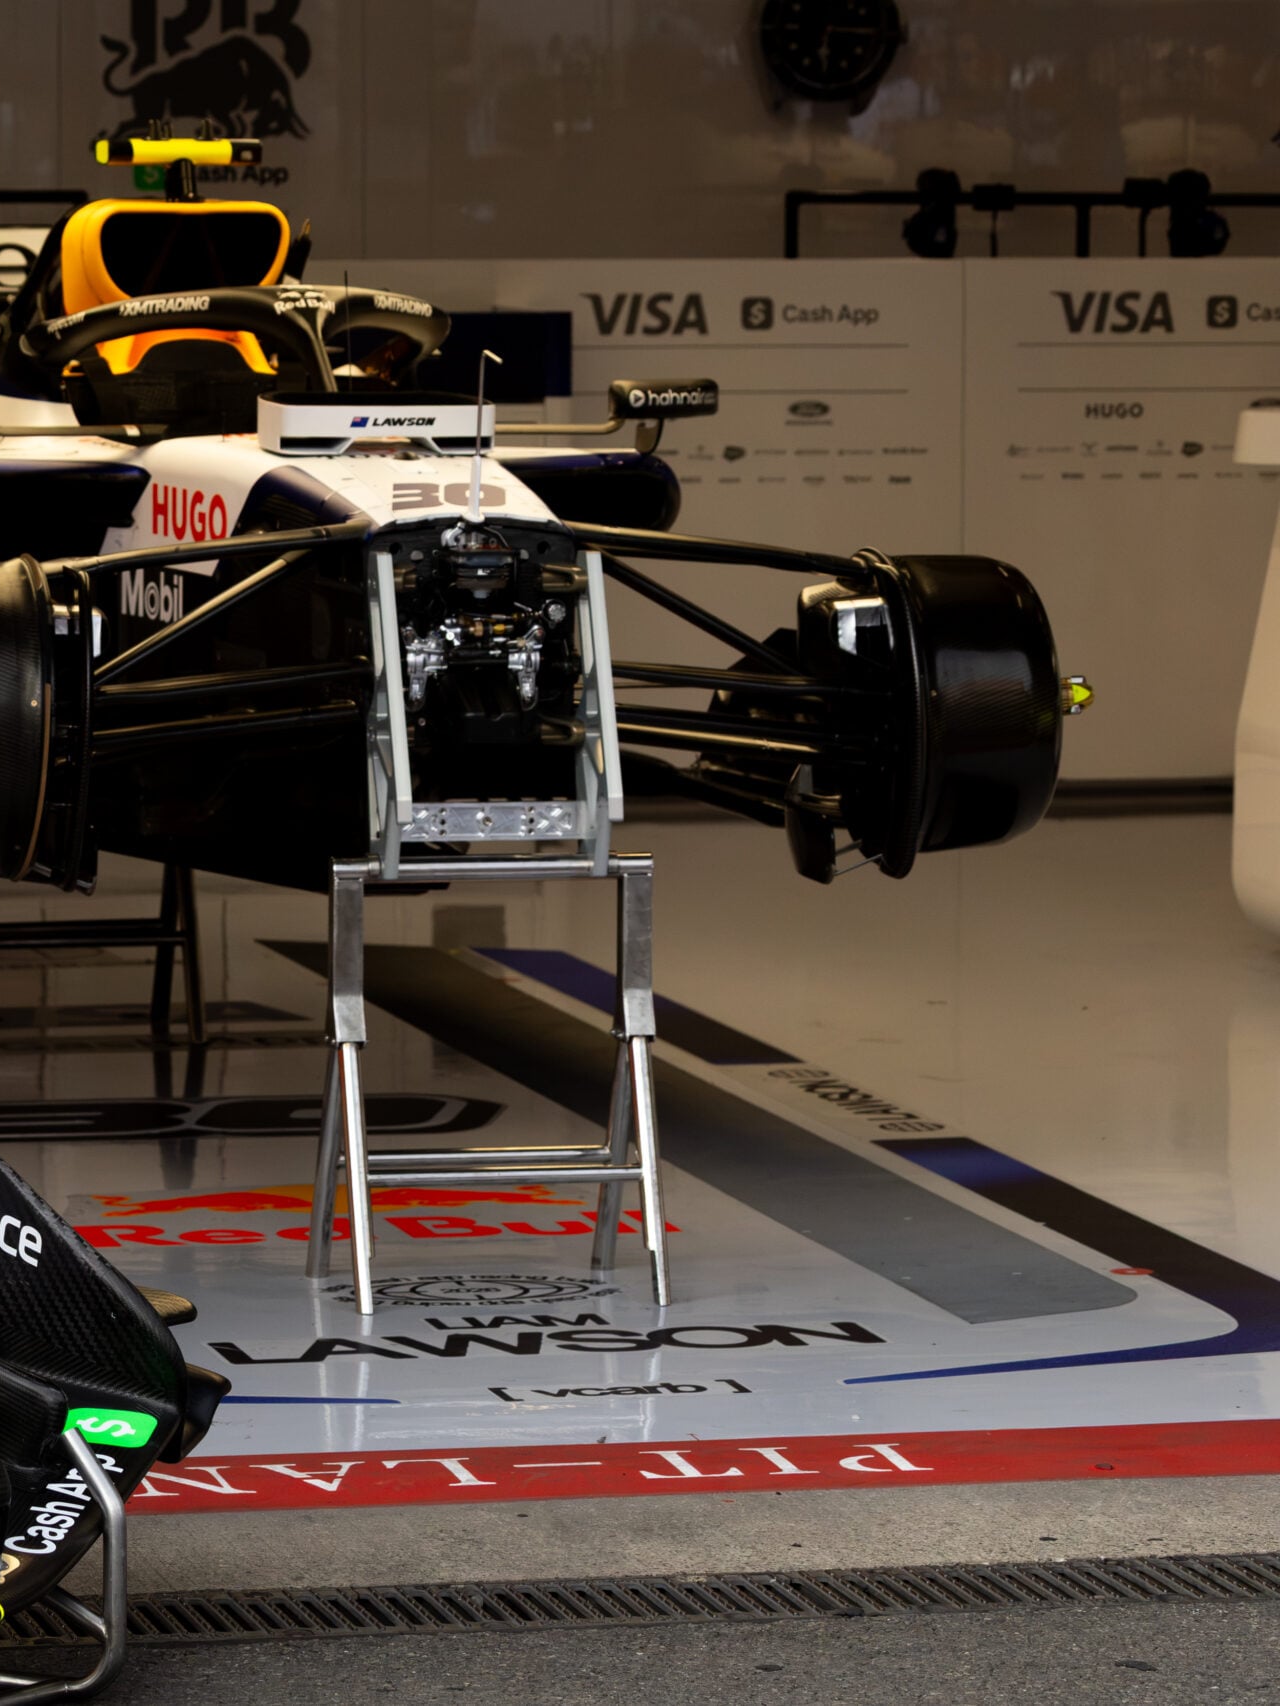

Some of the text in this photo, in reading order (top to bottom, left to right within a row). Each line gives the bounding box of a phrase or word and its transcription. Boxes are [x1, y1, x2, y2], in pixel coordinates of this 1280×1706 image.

[196, 163, 289, 186] ash App
[581, 293, 709, 336] VISA
[783, 303, 834, 325] Cash
[838, 303, 880, 326] App
[1050, 291, 1175, 334] VISA
[1246, 302, 1280, 322] Cas
[372, 417, 436, 427] LAWSON
[1084, 403, 1144, 419] HUGO
[392, 482, 507, 511] 30
[153, 484, 227, 542] HUGO
[121, 569, 184, 624] Mobil
[384, 1210, 681, 1239] Bull
[424, 1312, 611, 1330] LIAM
[207, 1321, 887, 1365] LAWSON
[529, 1381, 708, 1398] vcarb
[4, 1505, 82, 1555] Cash
